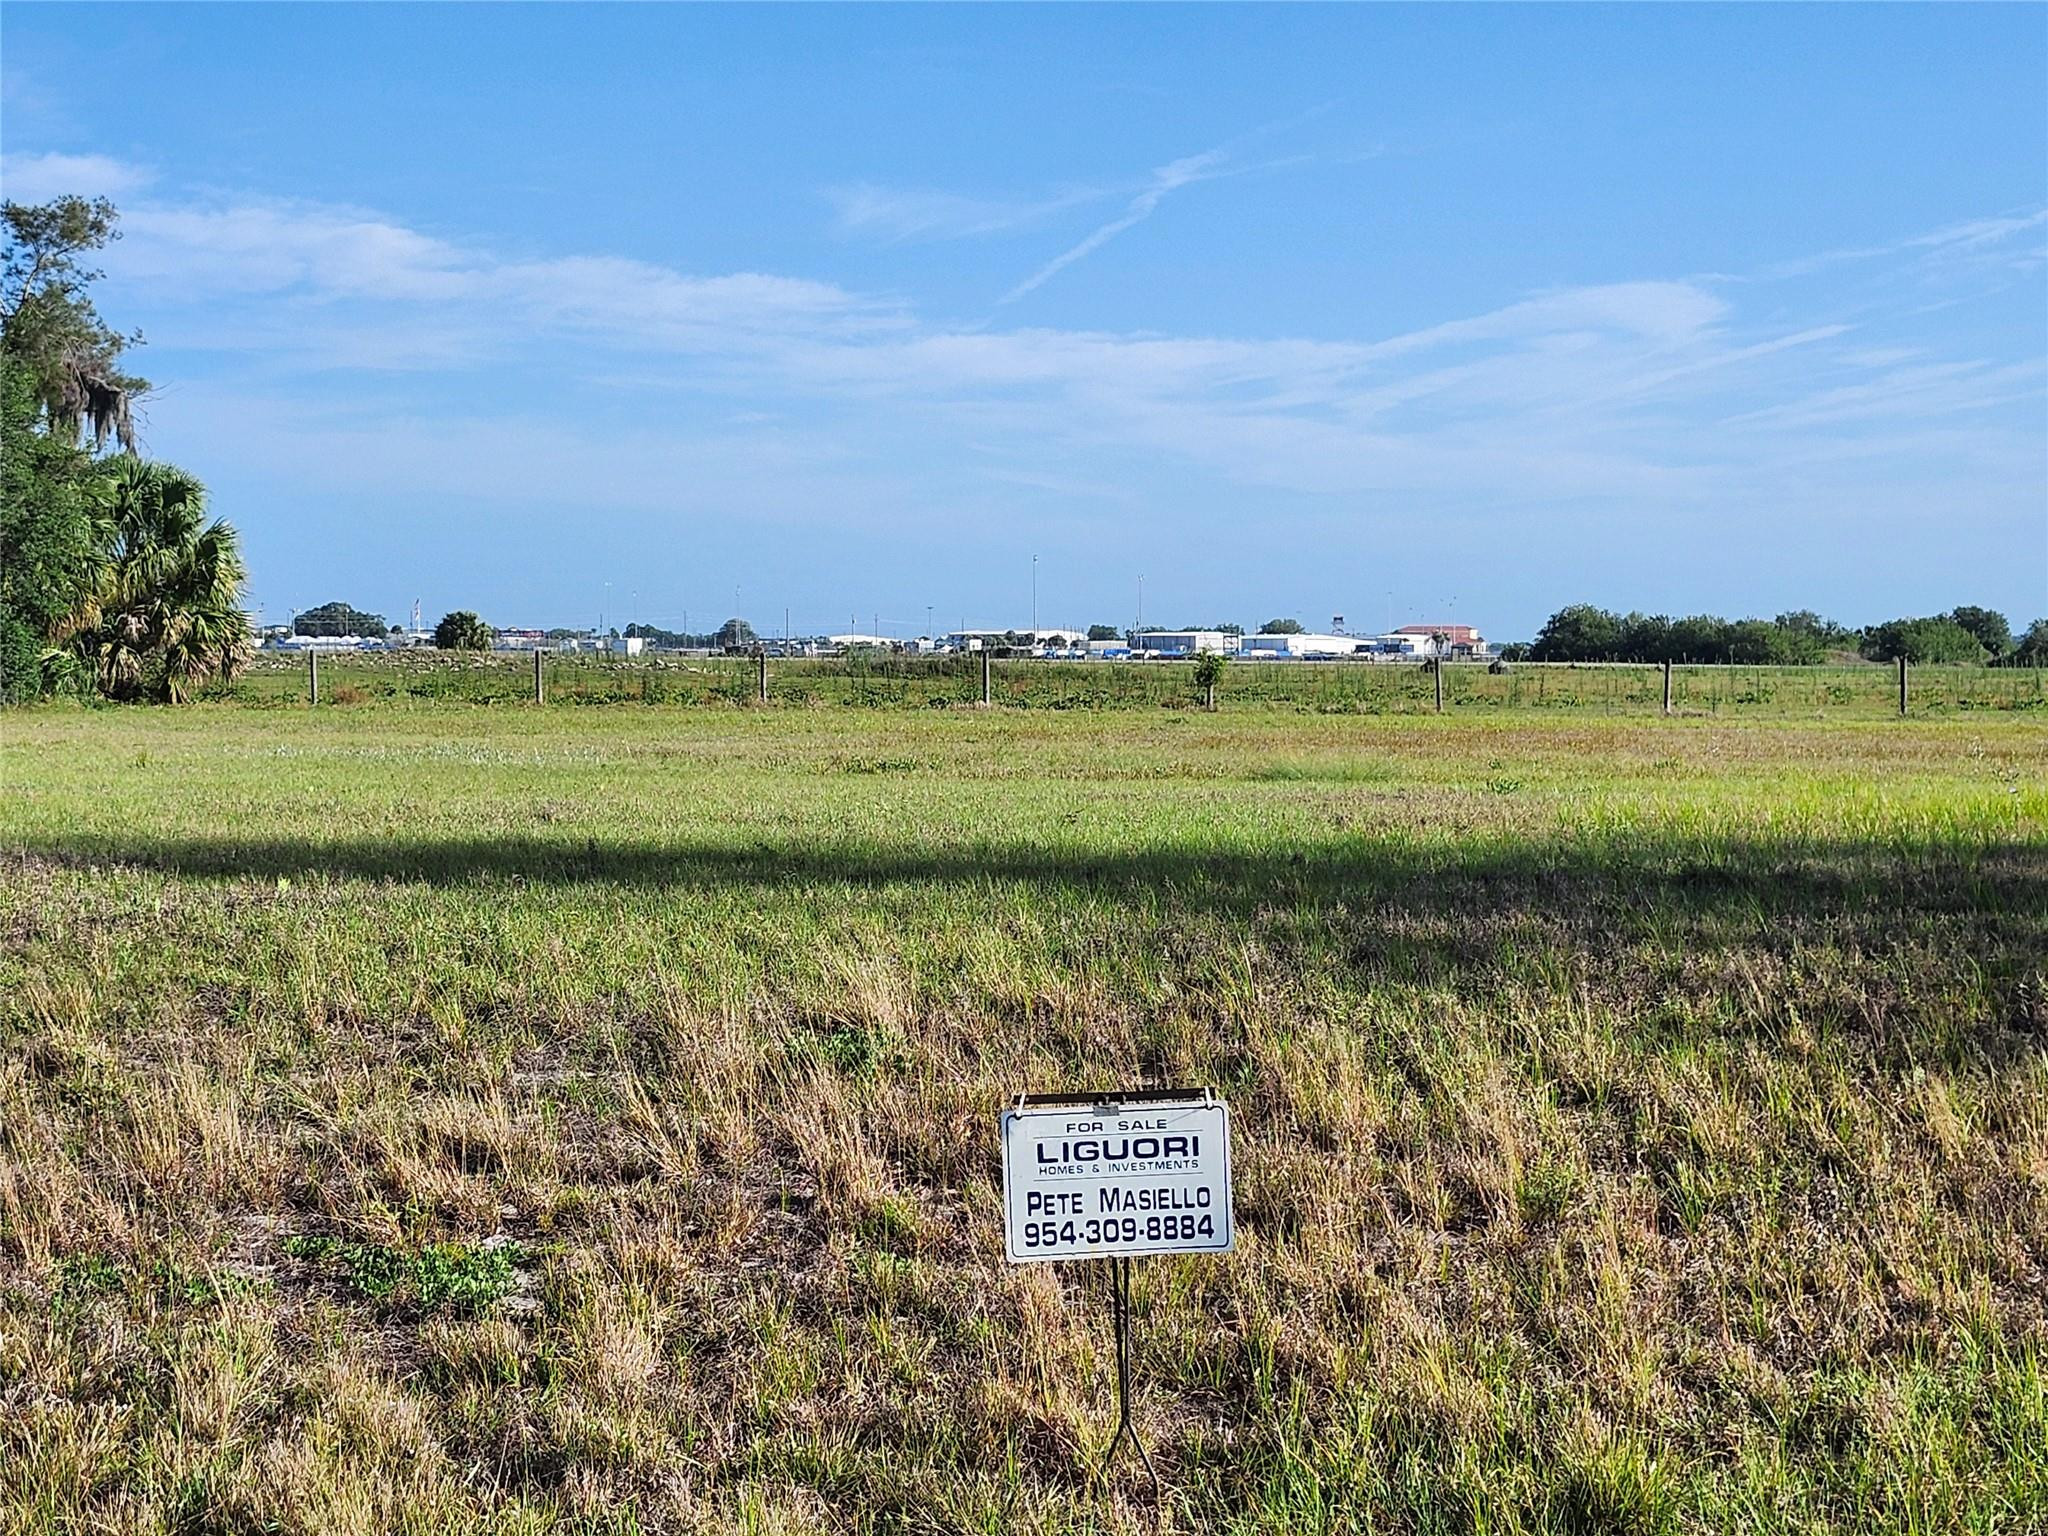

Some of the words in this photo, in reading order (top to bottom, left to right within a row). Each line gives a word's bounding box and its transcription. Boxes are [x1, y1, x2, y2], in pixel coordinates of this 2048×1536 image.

[1066, 1122, 1104, 1133] FOR
[1118, 1119, 1168, 1131] SALE
[1037, 1136, 1199, 1163] LIGUORI
[1039, 1165, 1084, 1175] HOMES
[1092, 1164, 1100, 1173] &
[1108, 1160, 1199, 1172] INVESTMENTS
[1027, 1191, 1084, 1216] PETE
[1100, 1187, 1211, 1213] MASIELLO
